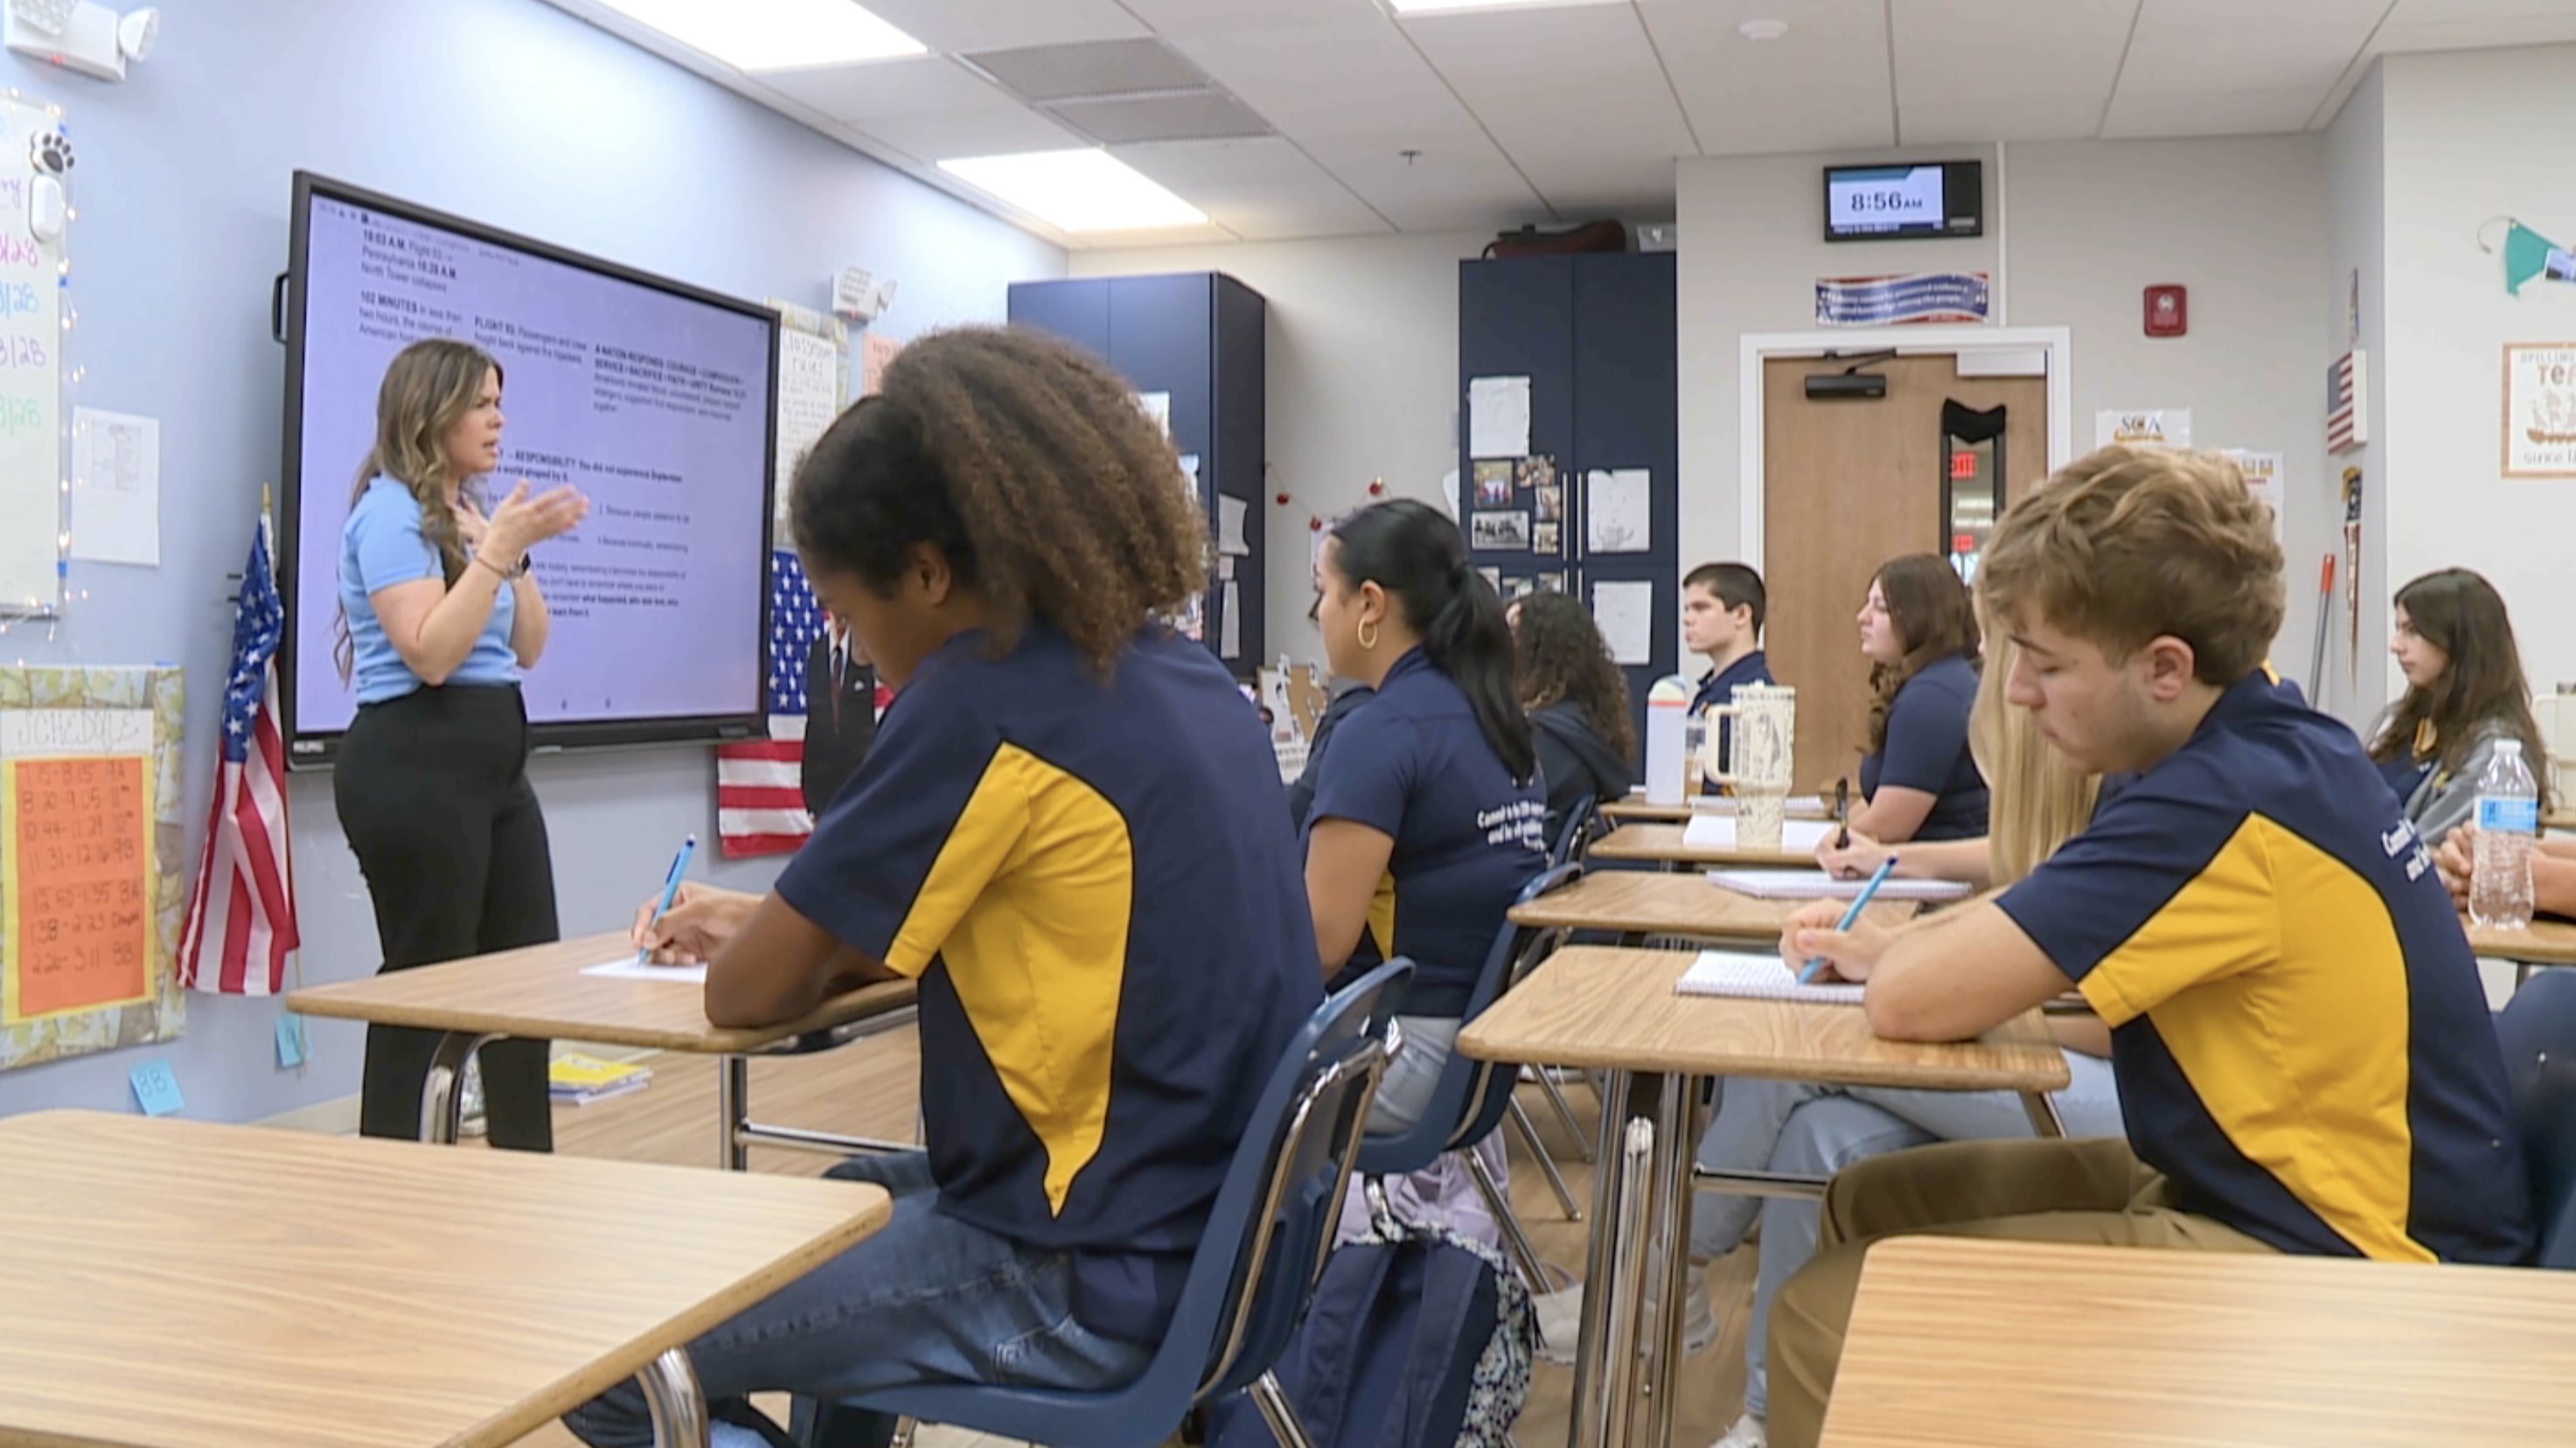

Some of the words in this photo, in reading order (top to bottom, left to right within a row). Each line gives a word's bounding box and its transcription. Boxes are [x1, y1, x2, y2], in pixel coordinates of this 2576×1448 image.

[1851, 191, 1903, 212] 8:56
[1904, 198, 1923, 211] AM
[361, 261, 384, 277] North
[386, 265, 410, 284] Tower
[378, 292, 417, 315] MINUTES
[137, 1068, 168, 1099] 8B
